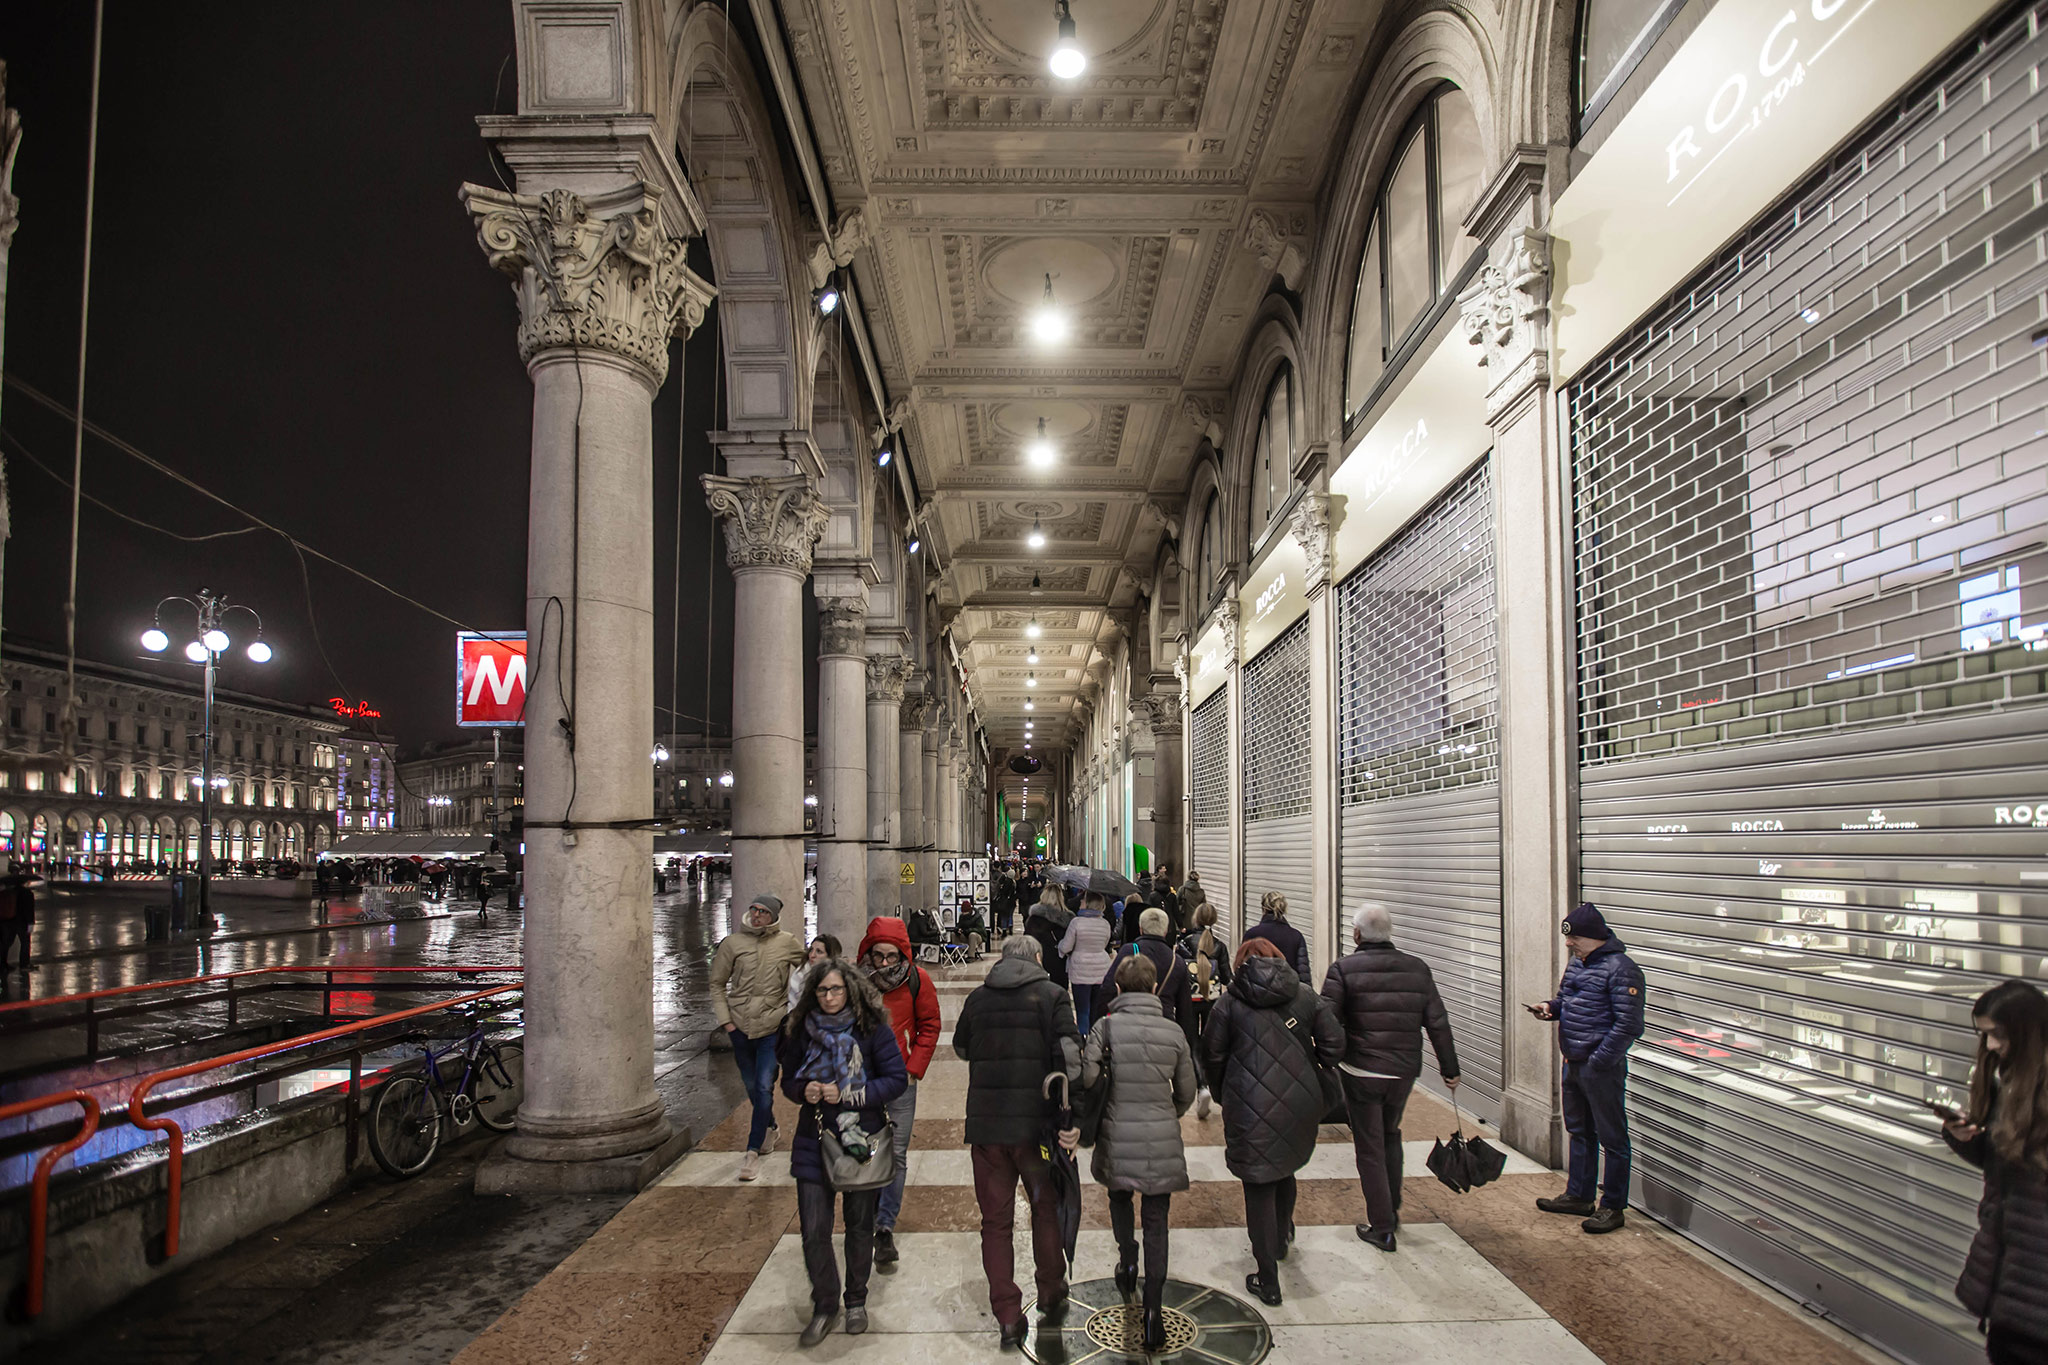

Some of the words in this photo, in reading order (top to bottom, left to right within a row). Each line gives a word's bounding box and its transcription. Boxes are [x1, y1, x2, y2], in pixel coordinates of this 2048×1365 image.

[1750, 61, 1806, 130] 1794
[1365, 417, 1428, 500] ROCCA
[1256, 572, 1286, 615] ROCCA
[466, 654, 528, 705] M
[329, 697, 381, 718] Ray-Ban
[1647, 825, 1688, 833] ROCCA
[1731, 820, 1784, 832] ROCCA
